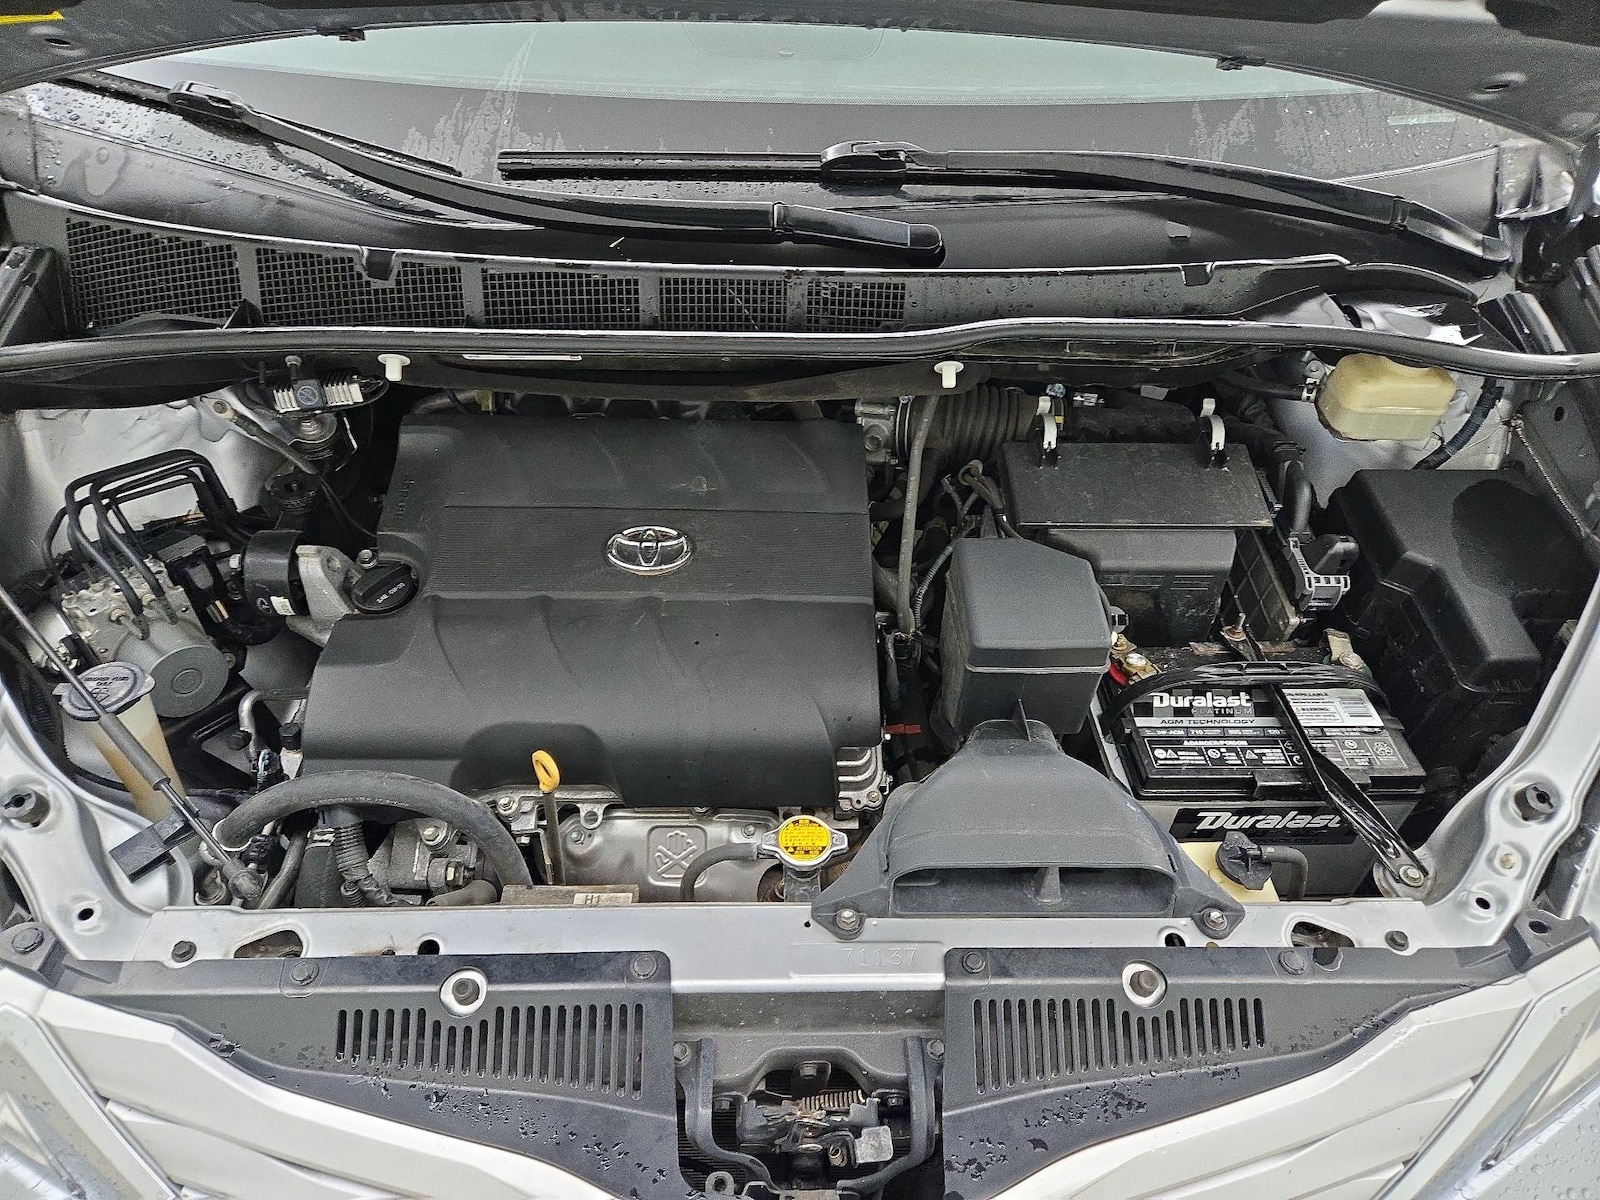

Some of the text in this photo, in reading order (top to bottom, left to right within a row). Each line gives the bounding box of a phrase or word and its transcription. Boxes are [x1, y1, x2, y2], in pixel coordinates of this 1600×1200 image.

[1148, 692, 1252, 707] Duralast
[1196, 811, 1343, 830] Duralast
[842, 947, 919, 967] 71137
